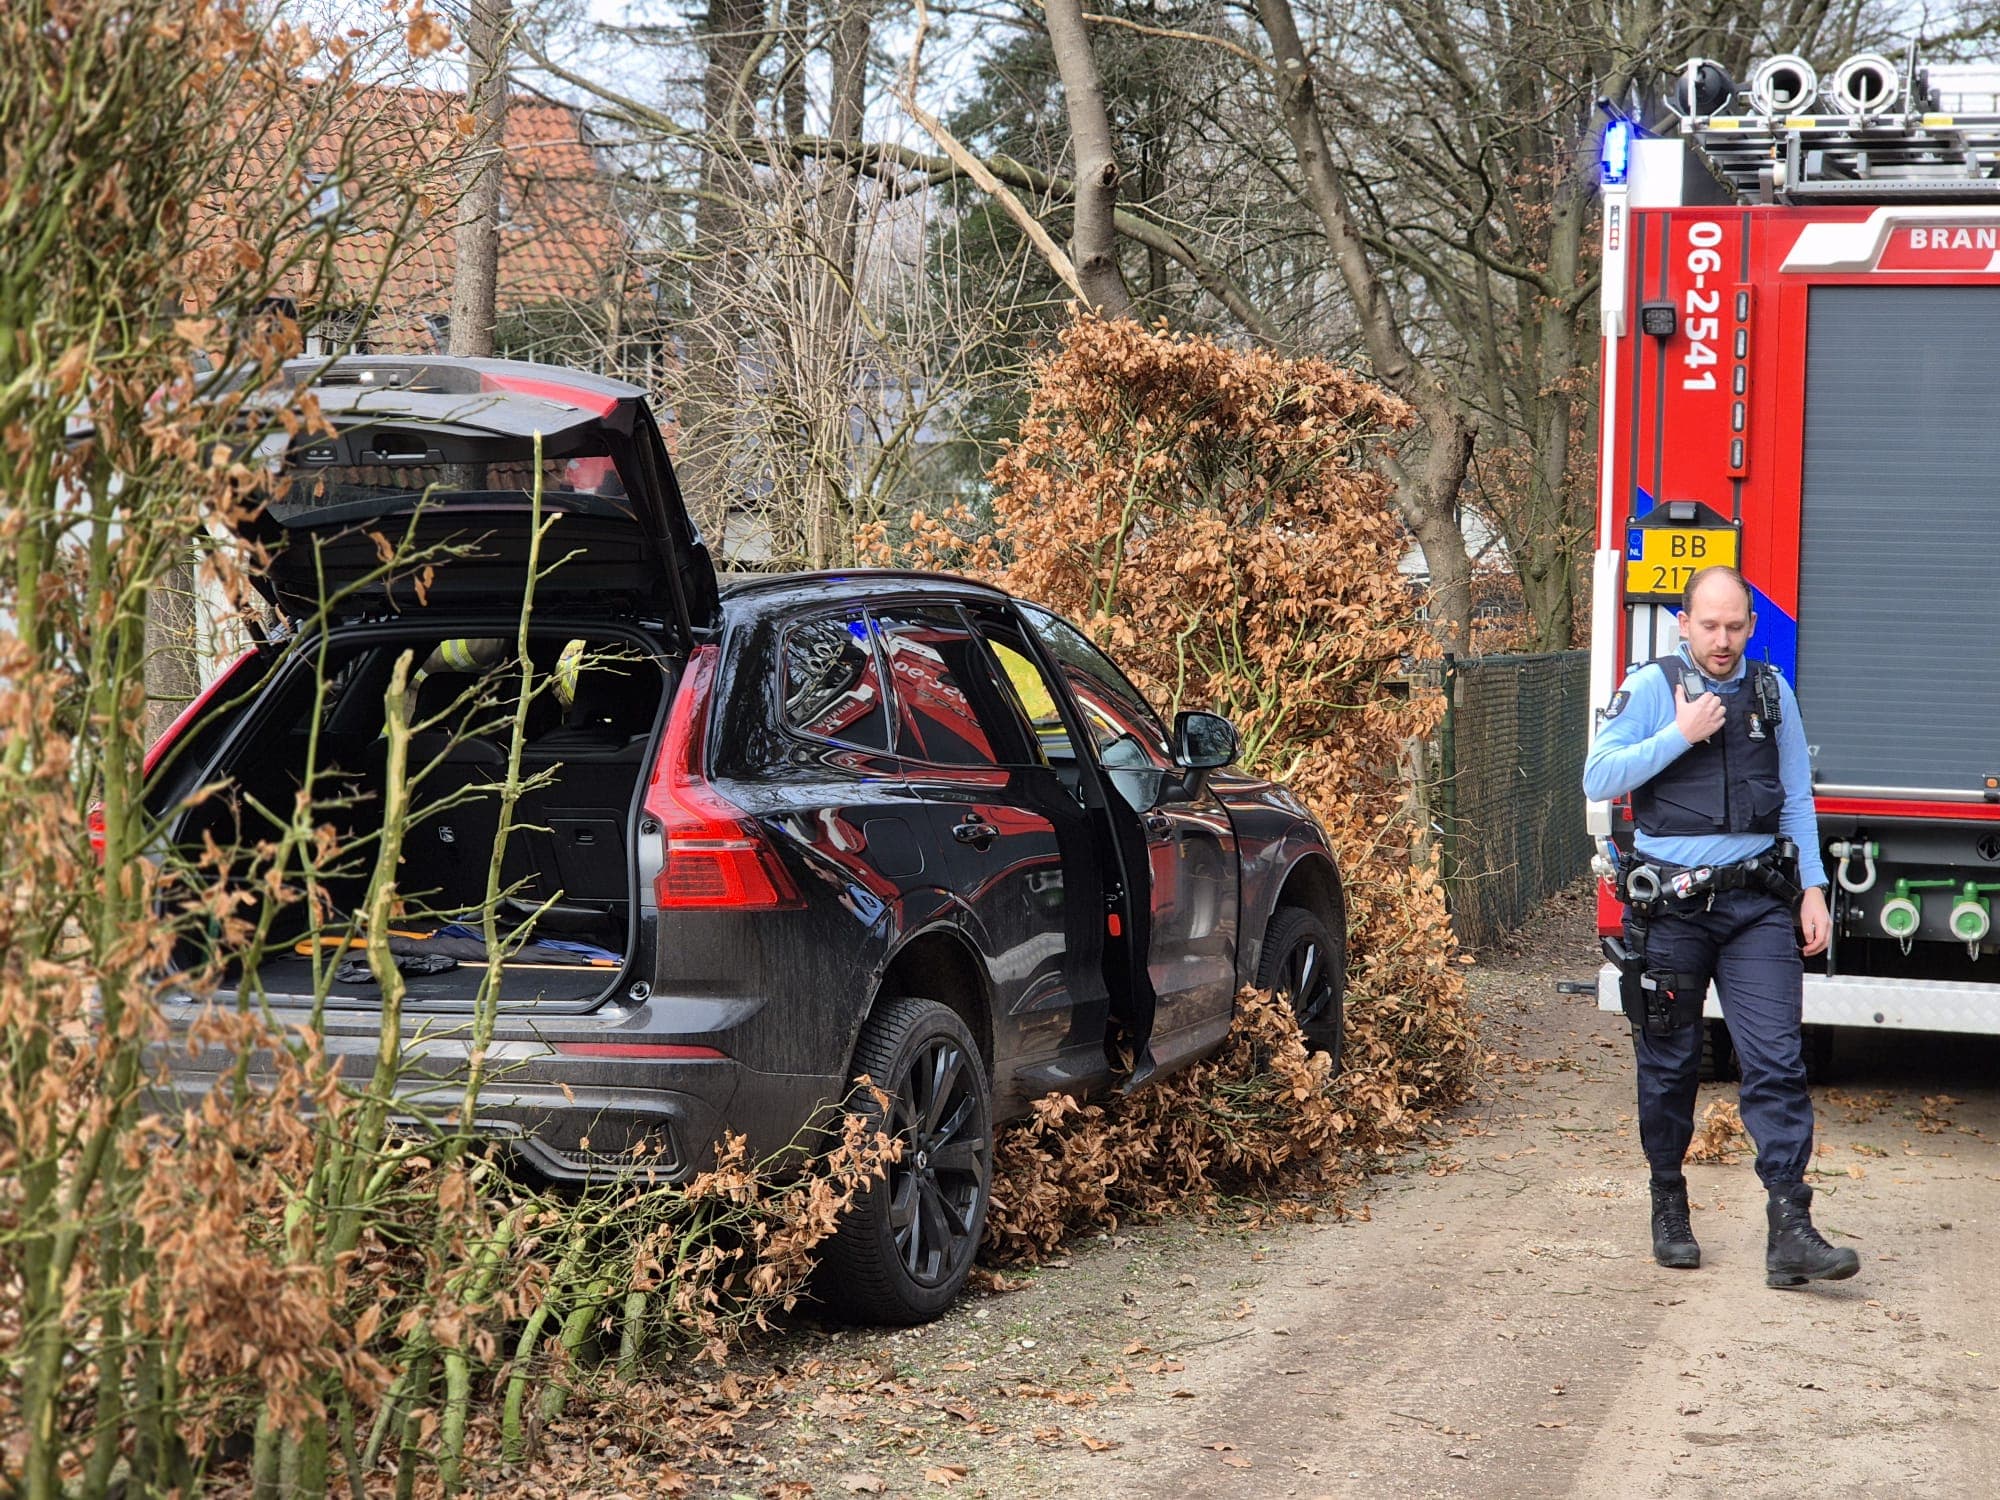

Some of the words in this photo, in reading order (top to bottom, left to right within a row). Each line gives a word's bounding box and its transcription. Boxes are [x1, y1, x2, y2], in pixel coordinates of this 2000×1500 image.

[1910, 228, 1997, 249] BRAN
[1682, 221, 1723, 390] 06-2541
[1629, 548, 1641, 557] NL
[1671, 535, 1707, 558] BB
